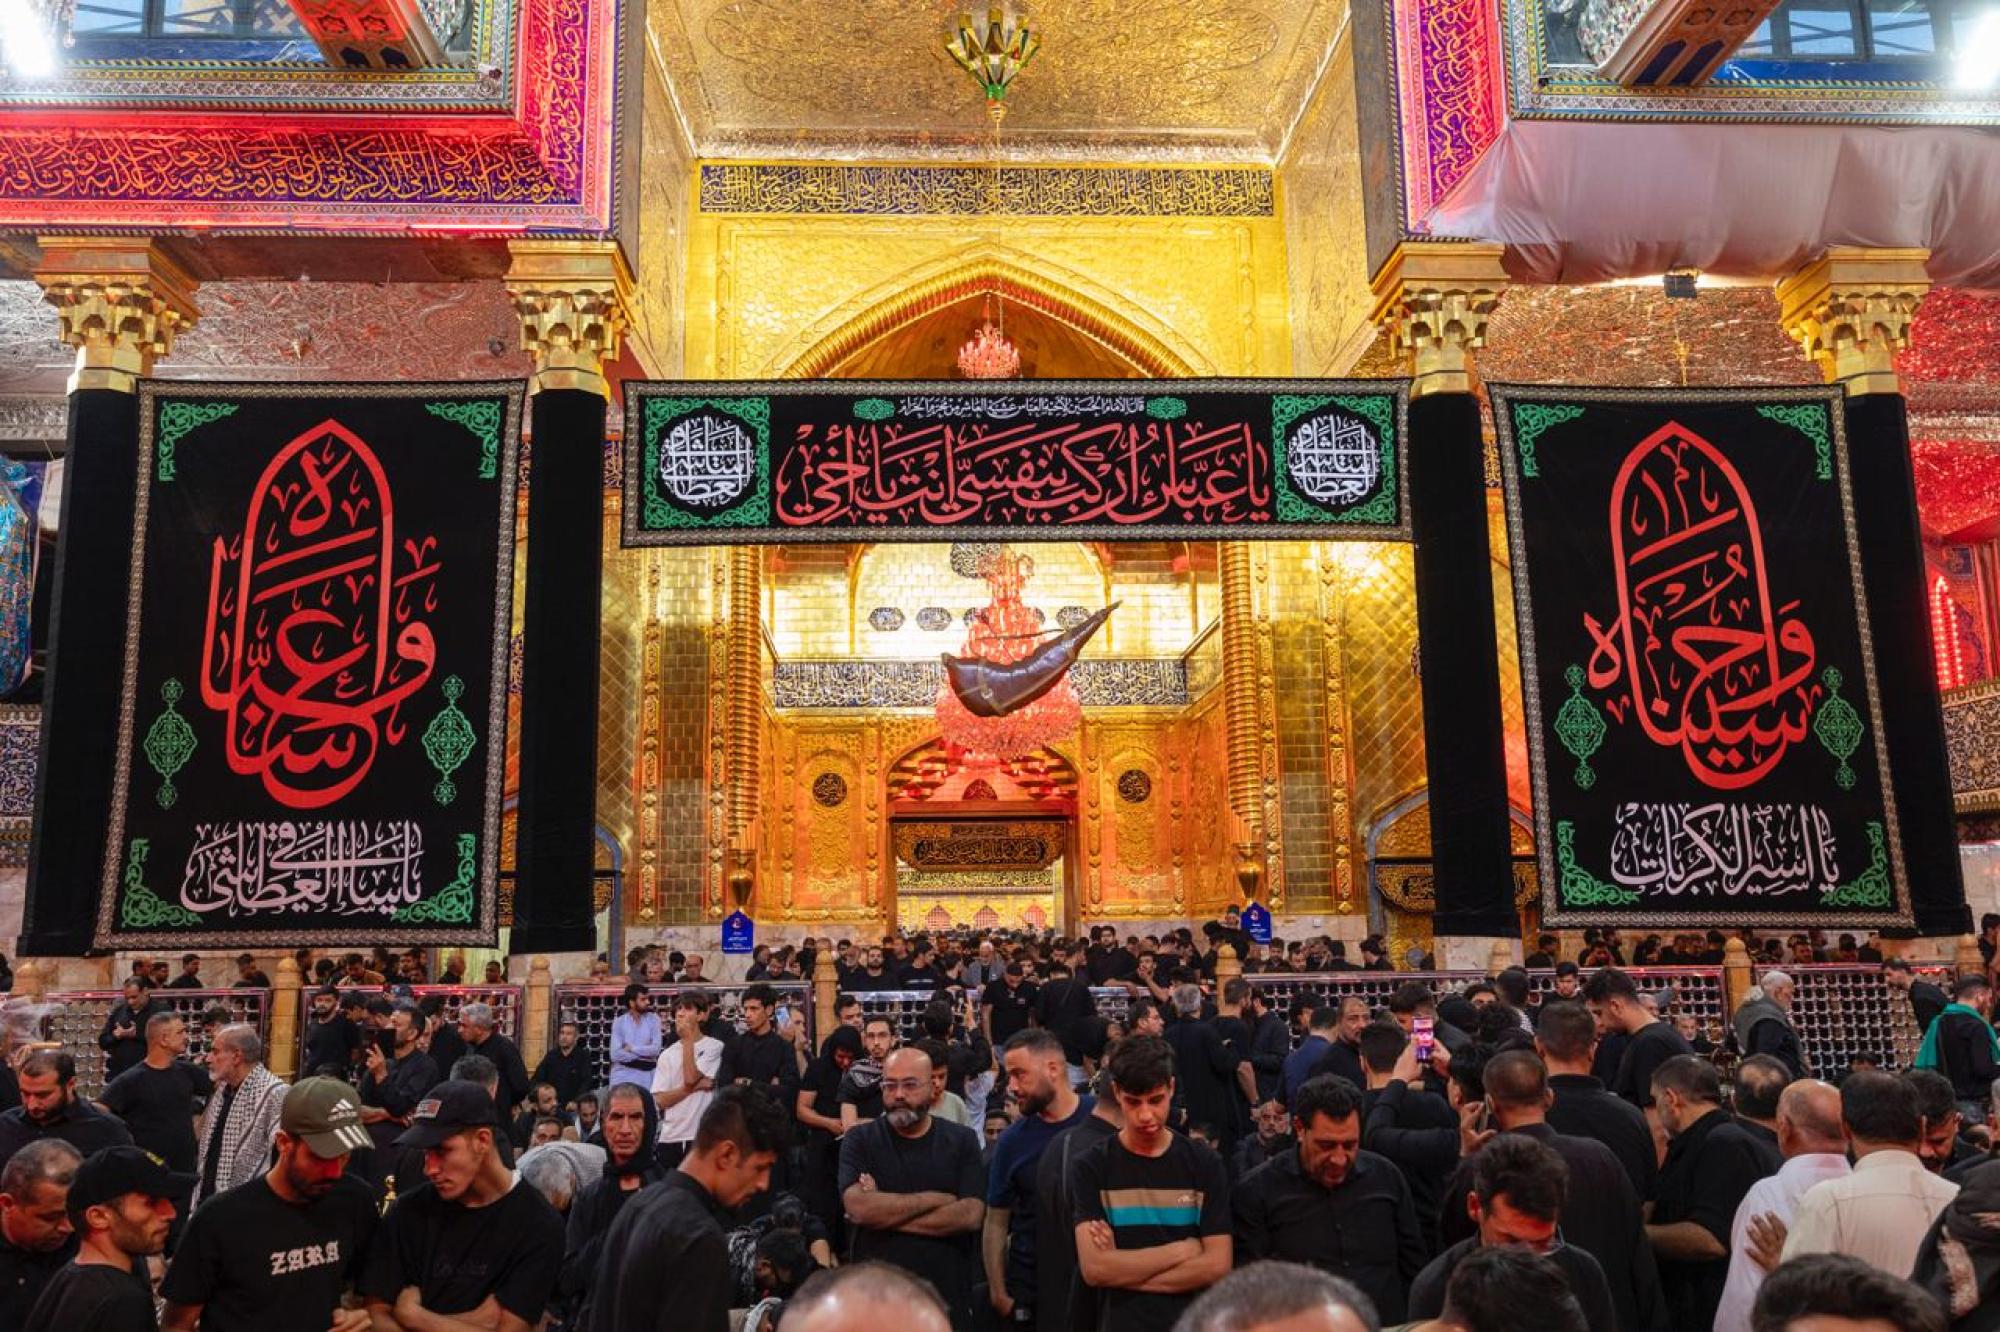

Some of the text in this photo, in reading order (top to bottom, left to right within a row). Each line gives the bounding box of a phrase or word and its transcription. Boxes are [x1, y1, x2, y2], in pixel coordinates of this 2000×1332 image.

[1104, 422, 1248, 524] عباس
[1243, 422, 1271, 522] يا
[1812, 804, 1840, 893] يا
[270, 1240, 340, 1275] ZARA
